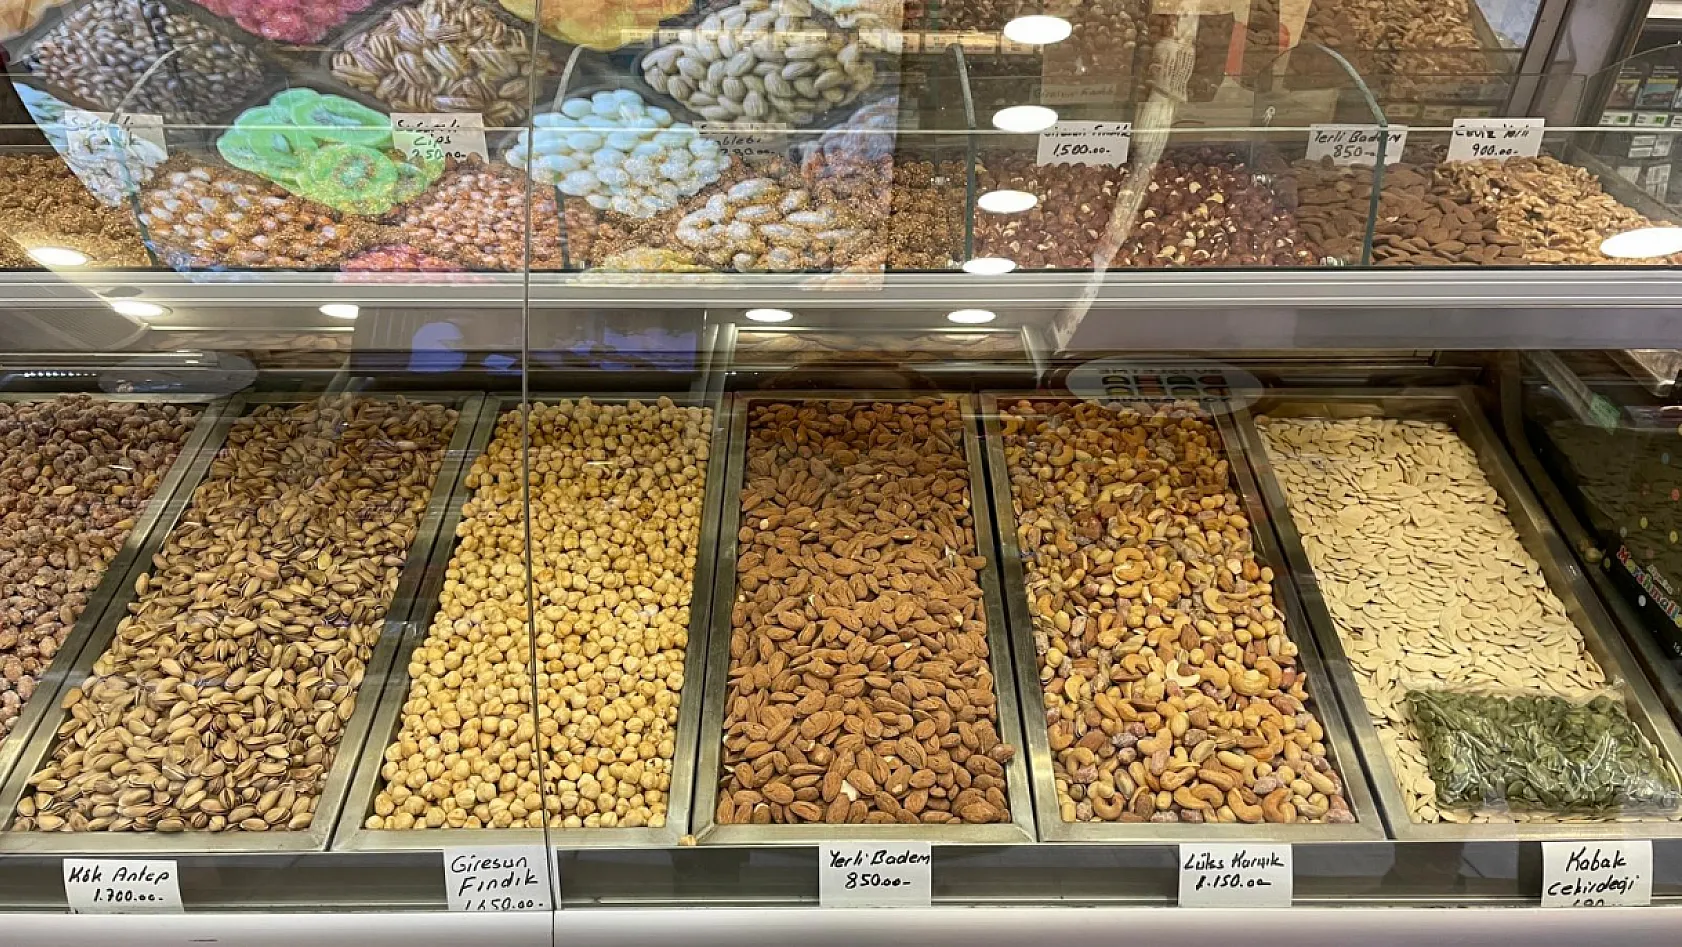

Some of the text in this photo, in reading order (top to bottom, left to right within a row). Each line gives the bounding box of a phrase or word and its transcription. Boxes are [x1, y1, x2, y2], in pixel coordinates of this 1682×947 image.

[451, 854, 528, 873] Giresun
[829, 849, 931, 868] Yerli Badem
[1184, 852, 1225, 871] Lüks
[1565, 846, 1627, 873] Kabak
[112, 865, 170, 885] Antep
[458, 868, 539, 896] Fındık
